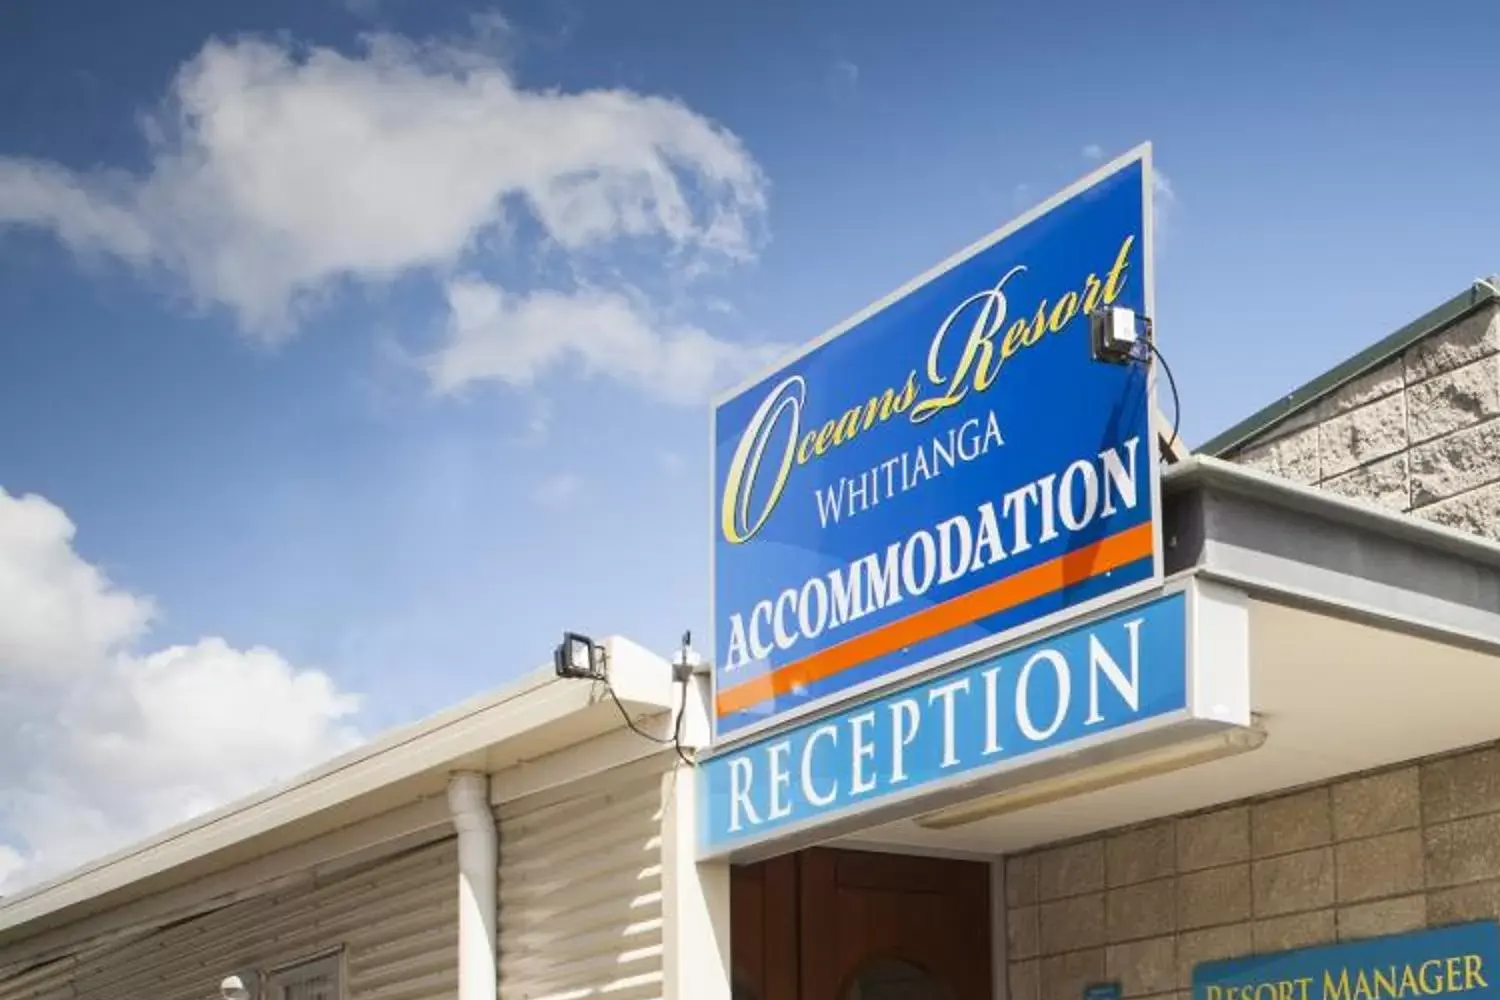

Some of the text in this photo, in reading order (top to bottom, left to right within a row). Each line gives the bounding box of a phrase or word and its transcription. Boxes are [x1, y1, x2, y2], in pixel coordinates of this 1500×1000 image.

[722, 235, 1134, 544] Oceans Resort
[816, 411, 1004, 528] WHITIANGA
[726, 438, 1141, 671] ACCOMMODATION
[727, 618, 1144, 832] RECEPTION
